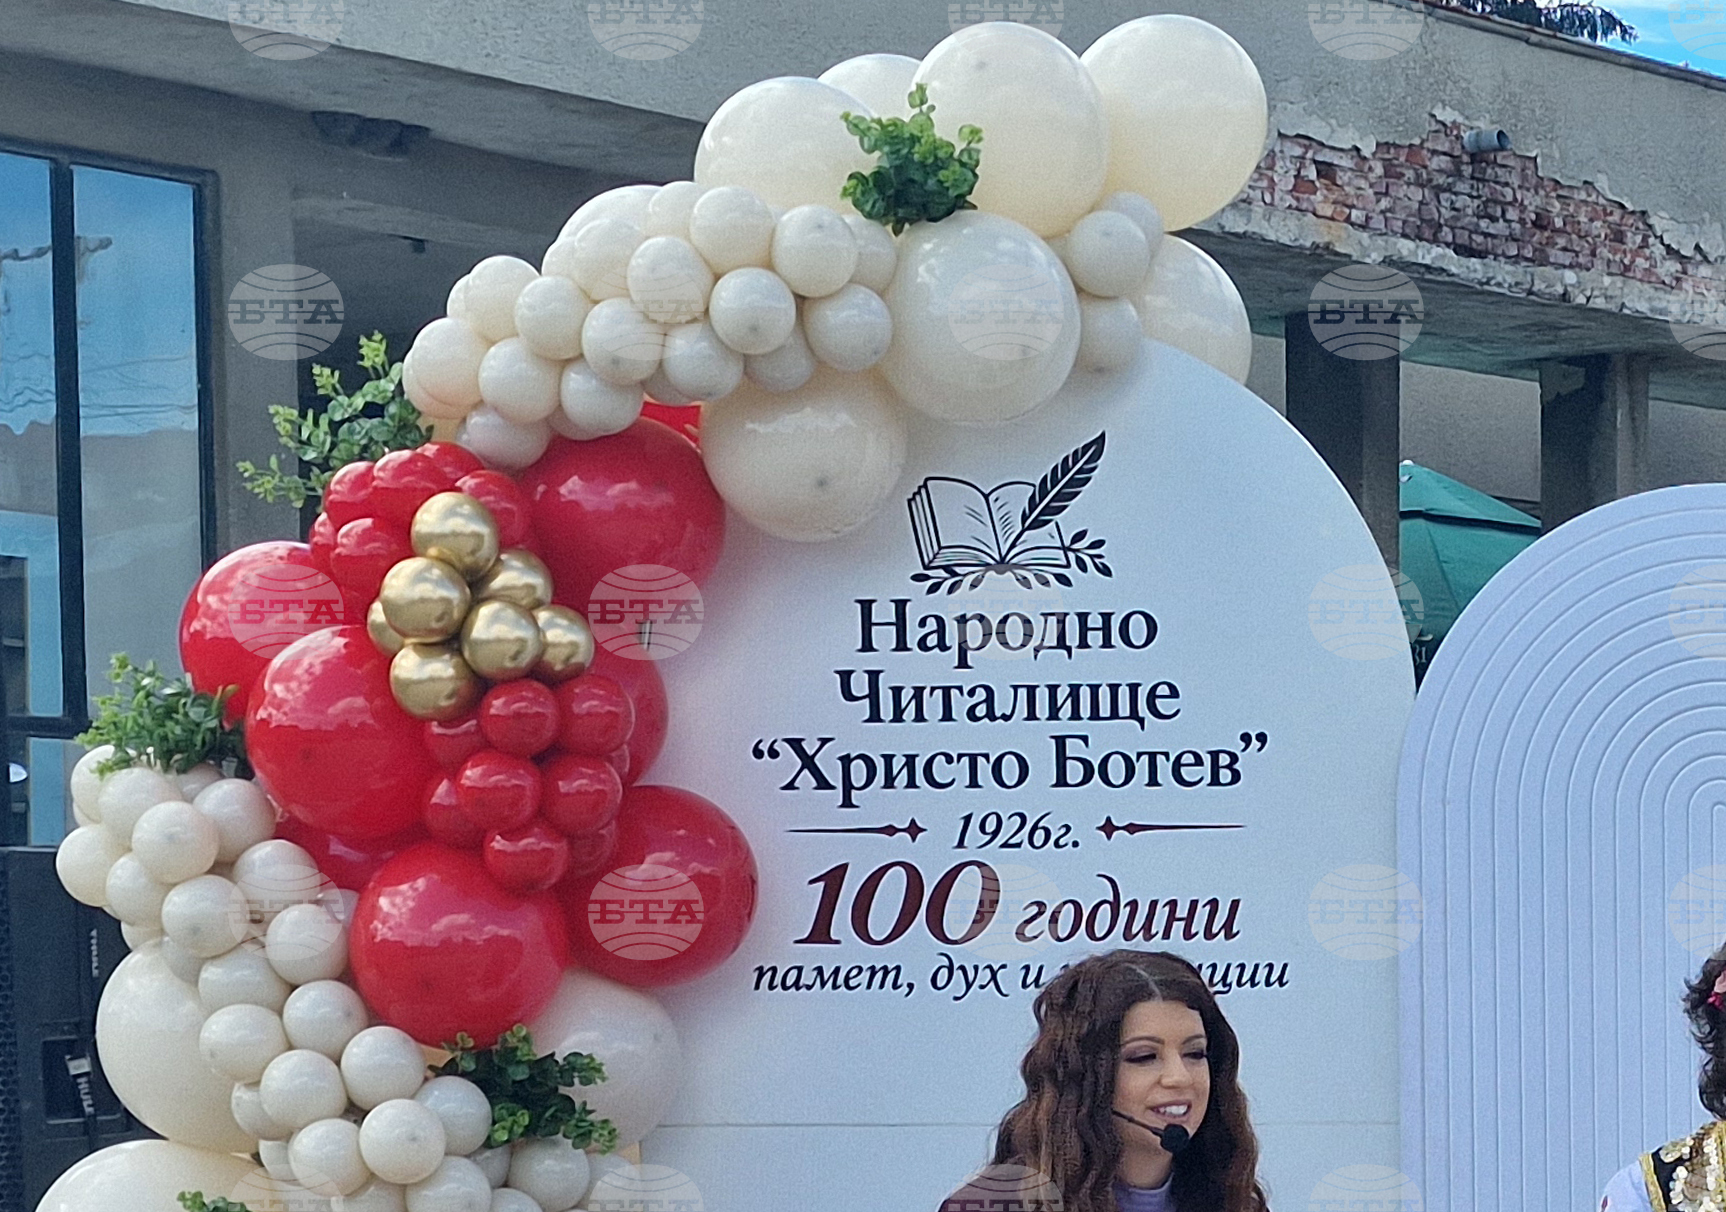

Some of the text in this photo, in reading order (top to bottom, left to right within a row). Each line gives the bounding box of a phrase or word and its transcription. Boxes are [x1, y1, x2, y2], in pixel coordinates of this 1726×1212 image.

[855, 598, 1158, 670] Народно
[835, 669, 1181, 732] Читалище
[752, 731, 1268, 807] “Христо Ботев”
[952, 811, 1082, 850] 1926г.
[794, 860, 1242, 946] 100 години
[754, 959, 915, 999] памет,
[930, 953, 1008, 1001] дух
[1019, 963, 1046, 990] и
